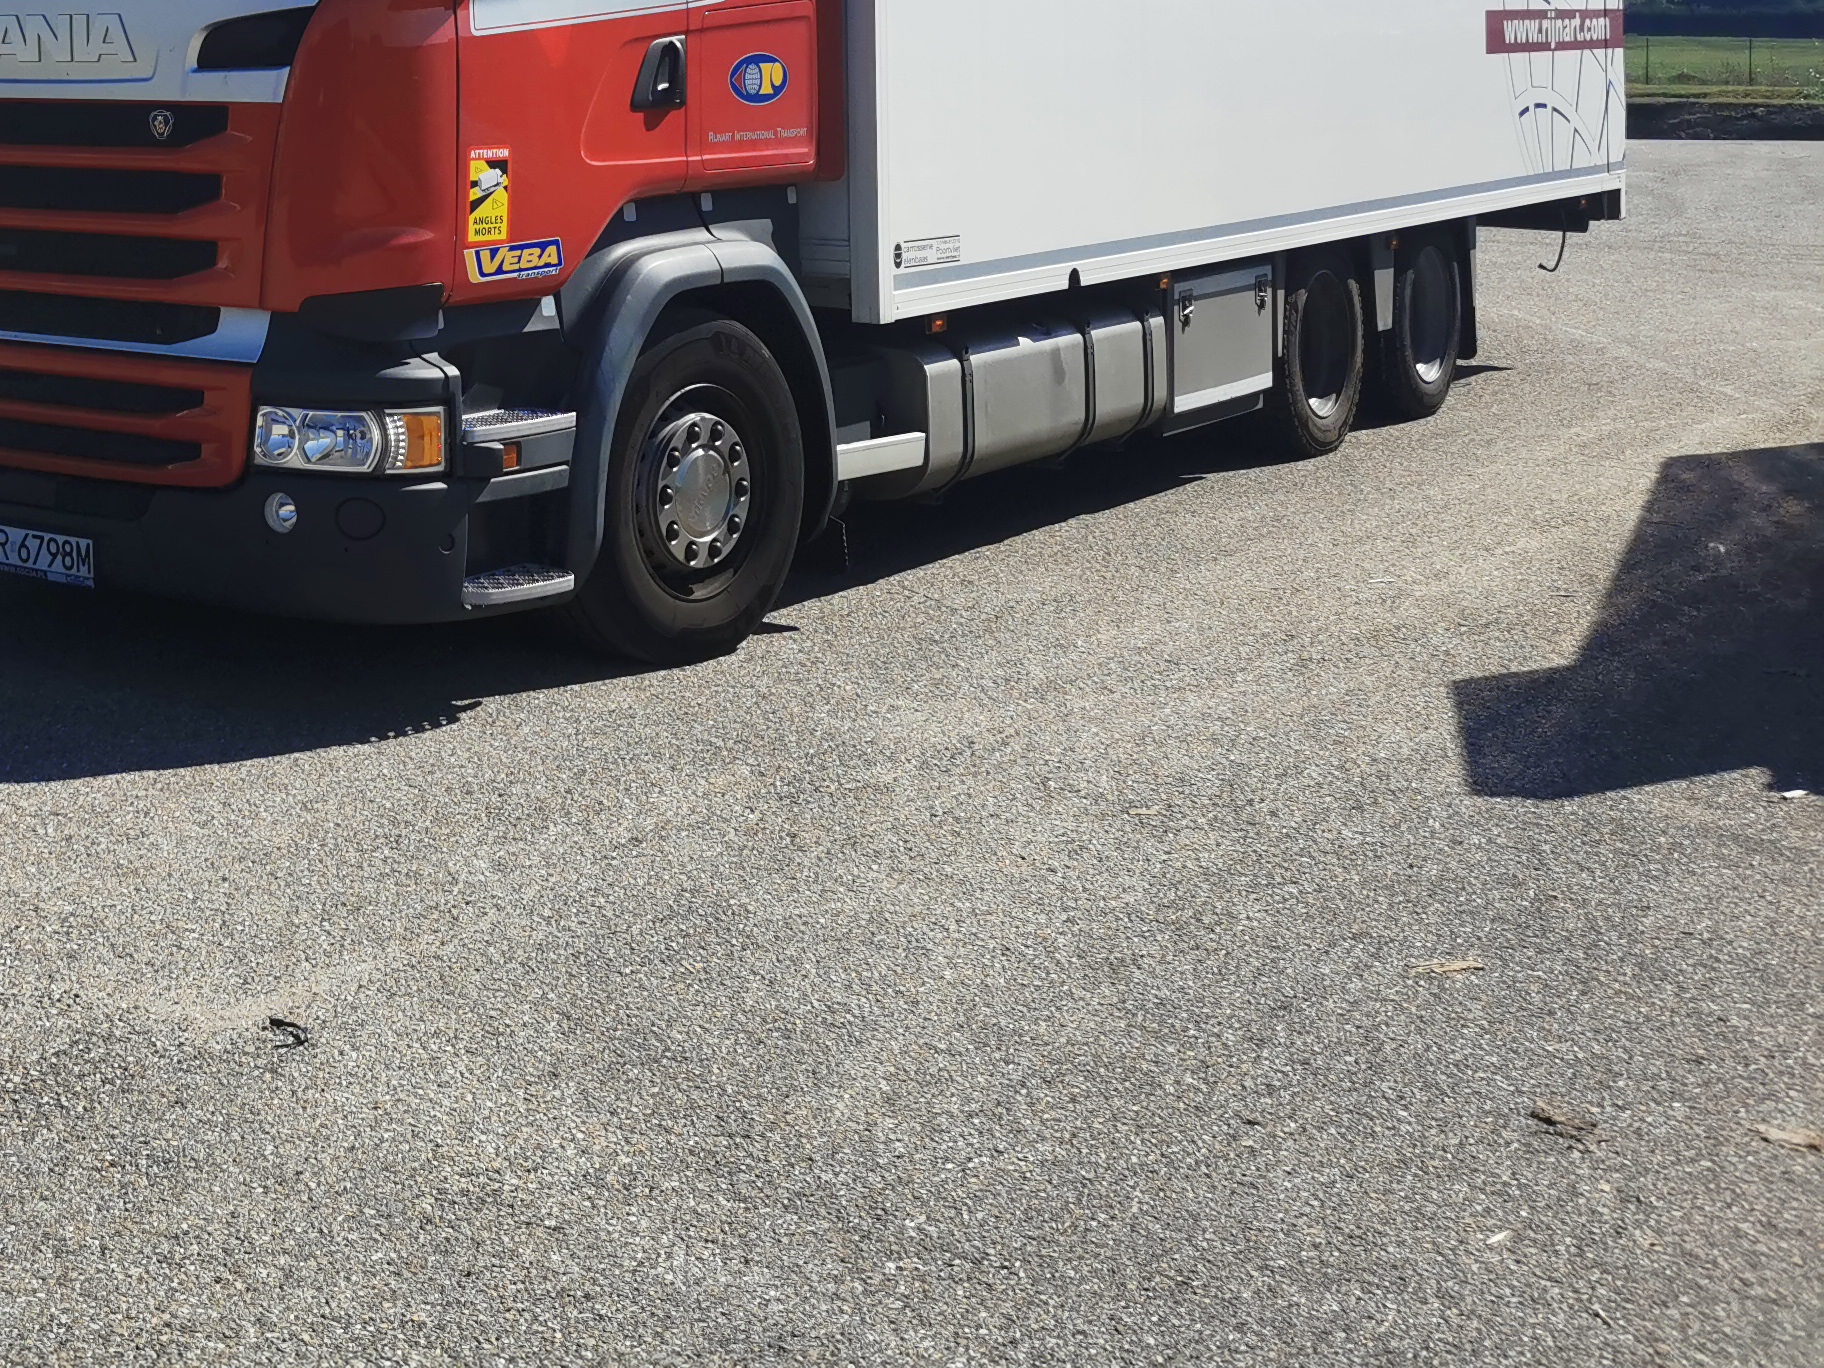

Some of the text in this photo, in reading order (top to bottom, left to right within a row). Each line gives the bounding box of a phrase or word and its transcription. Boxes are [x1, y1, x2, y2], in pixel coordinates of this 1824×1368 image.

[1502, 11, 1610, 49] www.rijnart.com
[470, 148, 510, 159] ATTENTION
[472, 215, 504, 227] ANGLES
[474, 226, 502, 237] MORTS
[479, 245, 559, 275] VEBA
[516, 267, 560, 280] transport
[17, 532, 92, 575] 6798M
